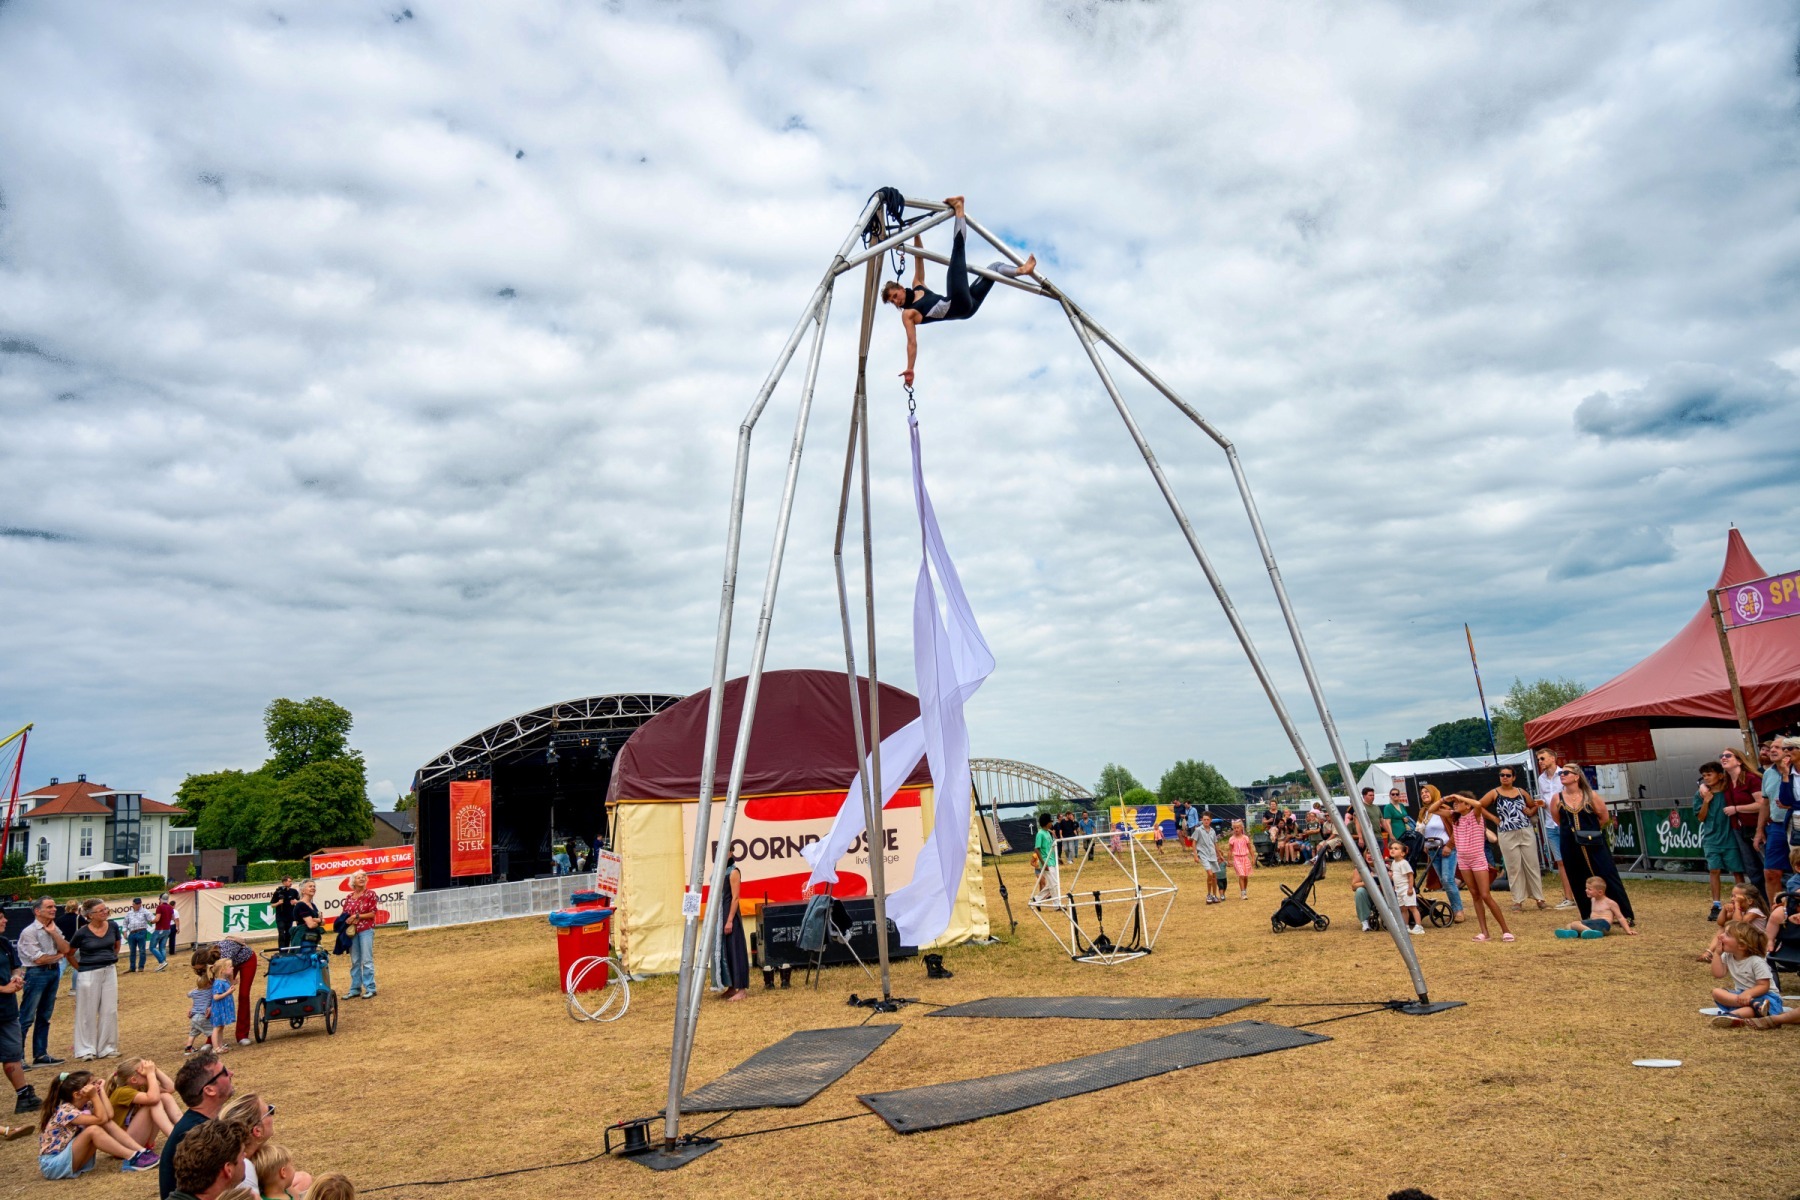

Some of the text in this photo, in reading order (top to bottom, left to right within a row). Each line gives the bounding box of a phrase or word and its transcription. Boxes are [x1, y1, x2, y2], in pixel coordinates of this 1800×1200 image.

[457, 840, 485, 852] STEK
[711, 828, 899, 864] OORNOSE
[314, 853, 412, 871] DOORNROOSJE LIVE STAGE
[228, 892, 275, 902] NOODUITGA
[324, 891, 404, 910] DOOOSJE
